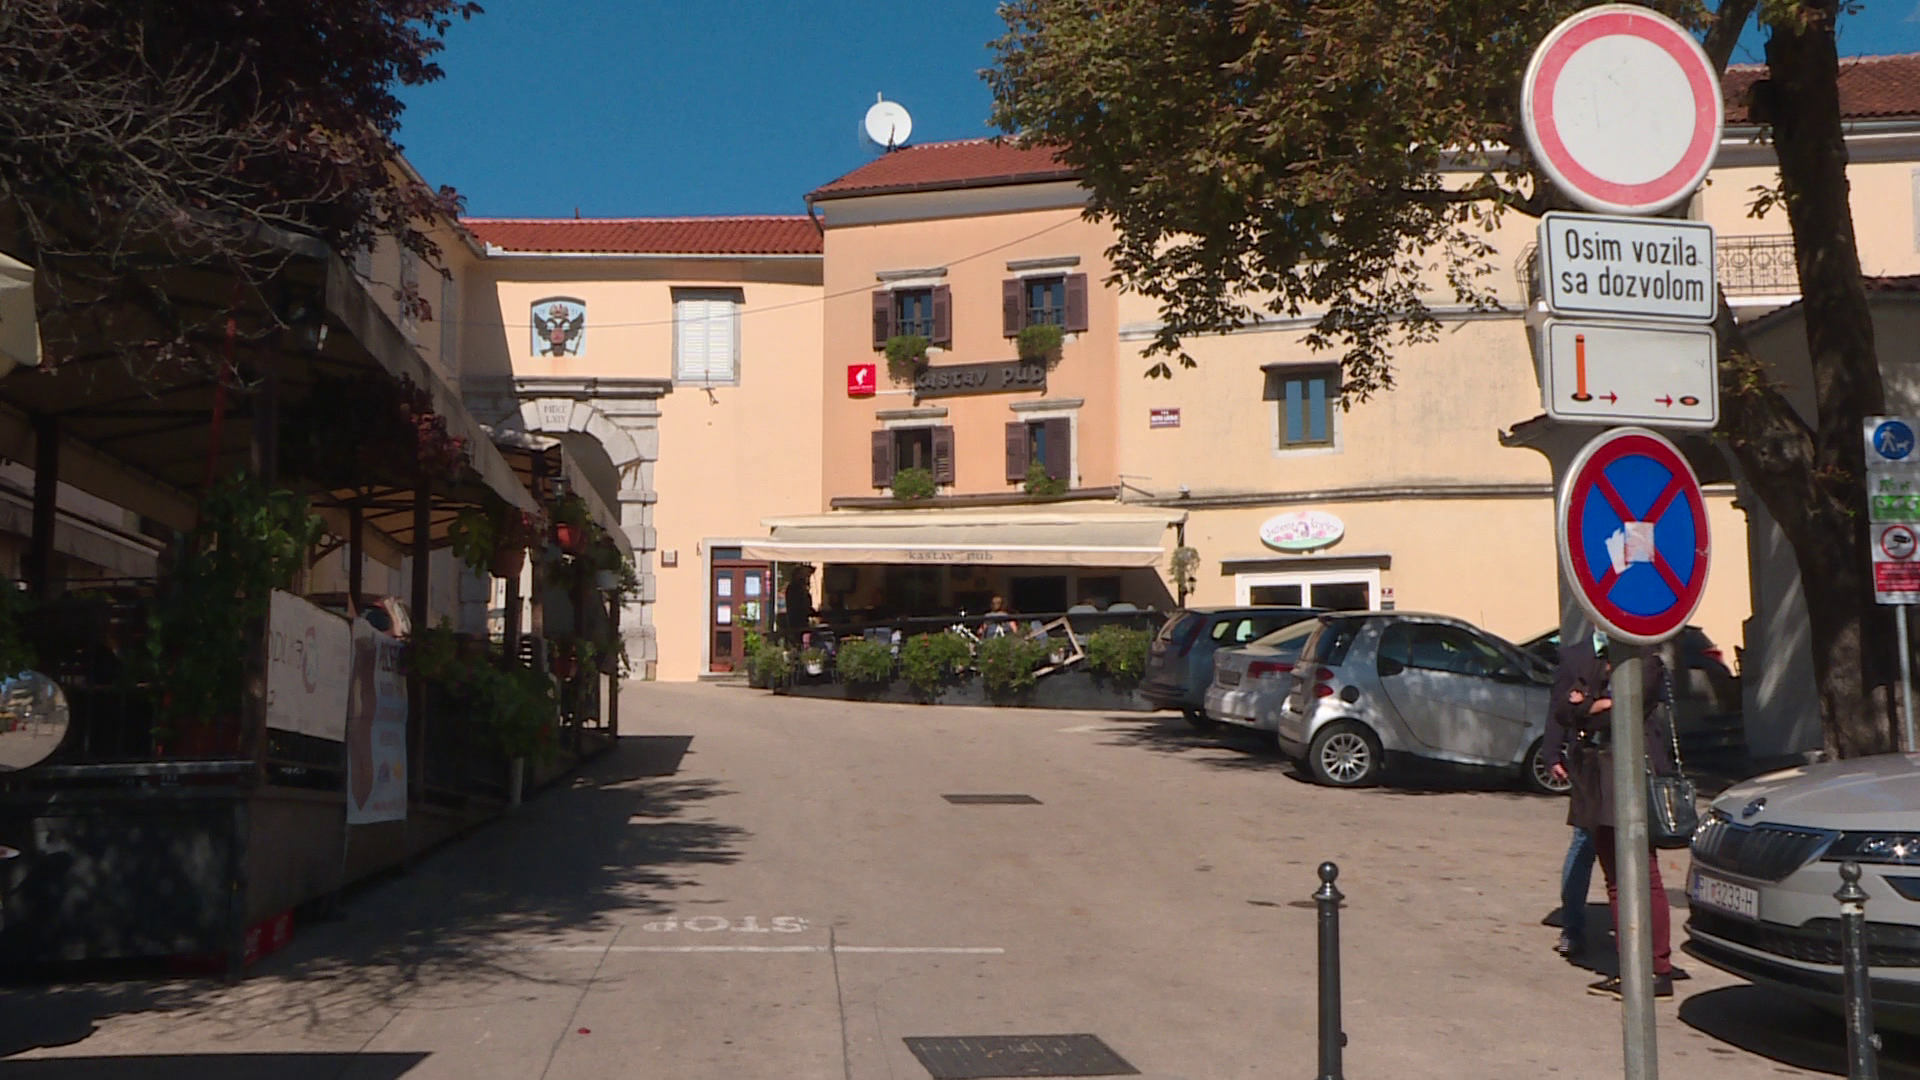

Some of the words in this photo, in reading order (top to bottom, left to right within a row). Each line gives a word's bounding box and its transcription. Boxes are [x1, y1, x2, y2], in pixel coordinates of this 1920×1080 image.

[1565, 229, 1622, 262] Osim
[1632, 236, 1697, 266] vozila
[1561, 271, 1588, 294] sa
[1599, 265, 1704, 302] dozvolom
[1001, 364, 1044, 388] pub
[643, 915, 809, 933] STOP
